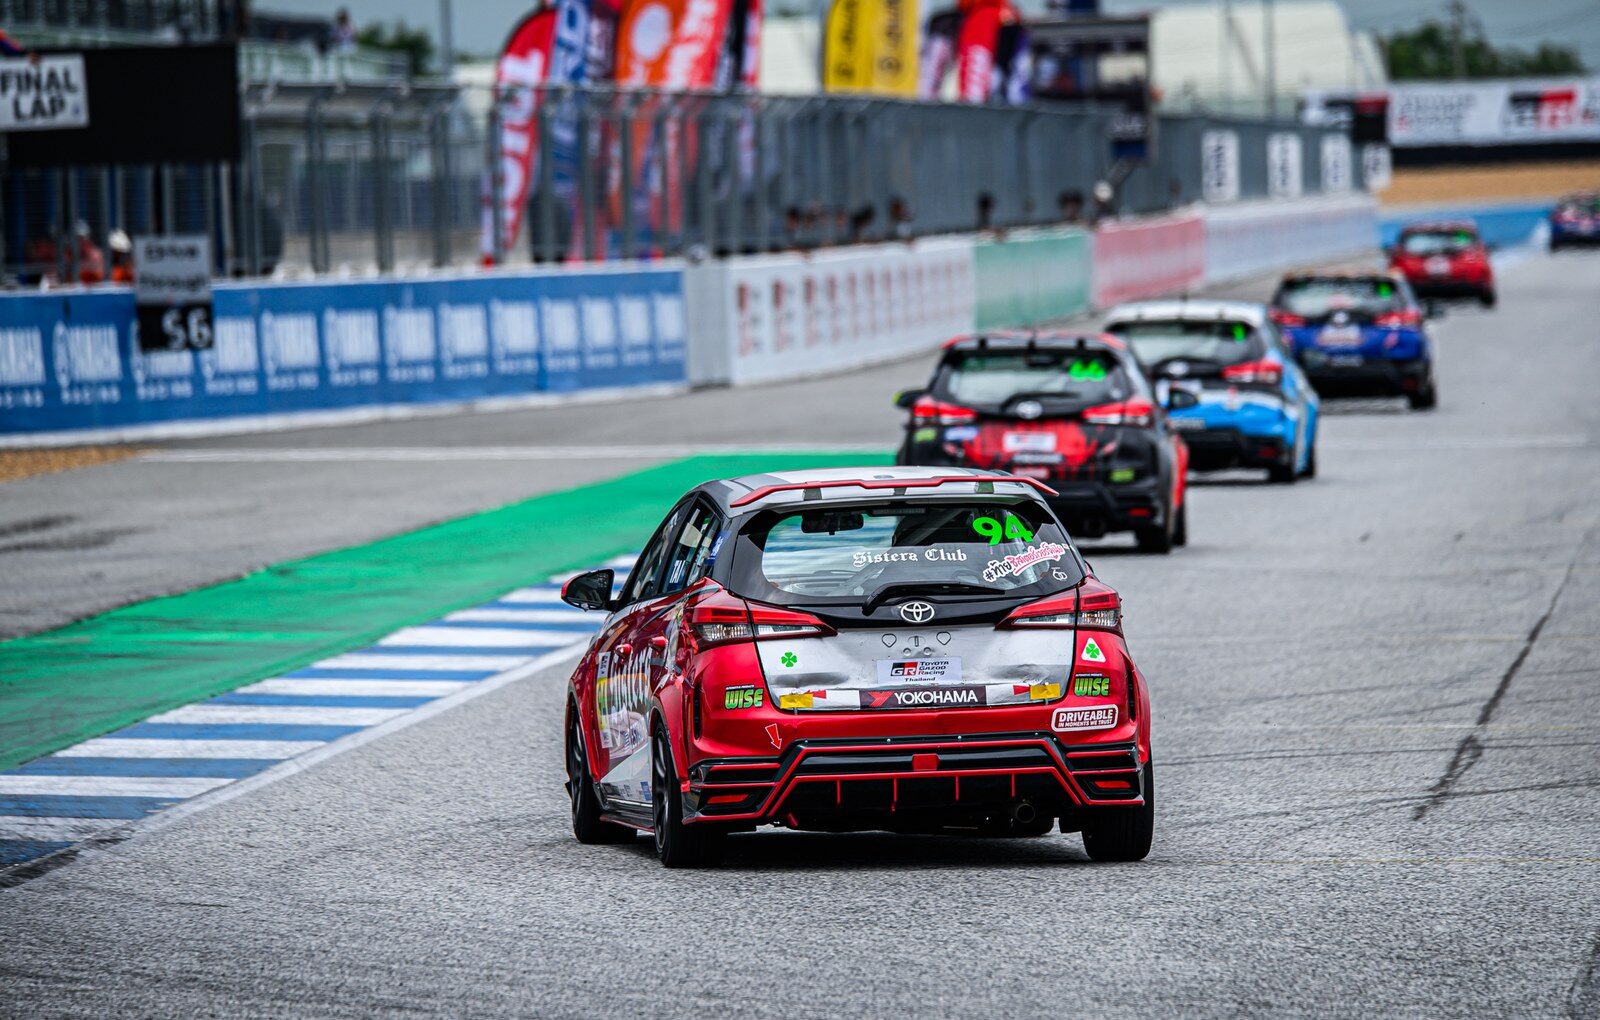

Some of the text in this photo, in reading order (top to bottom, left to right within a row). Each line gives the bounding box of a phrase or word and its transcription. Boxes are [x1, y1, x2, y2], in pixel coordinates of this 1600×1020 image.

[0, 66, 78, 95] FINAL
[13, 94, 66, 121] LAP
[972, 515, 1033, 546] 94
[924, 548, 967, 561] Club
[891, 666, 918, 676] GR
[894, 690, 978, 704] YOKOHAMA
[1074, 677, 1110, 697] WISE
[725, 688, 763, 710] WISE
[1058, 709, 1113, 723] DRIVEABLE
